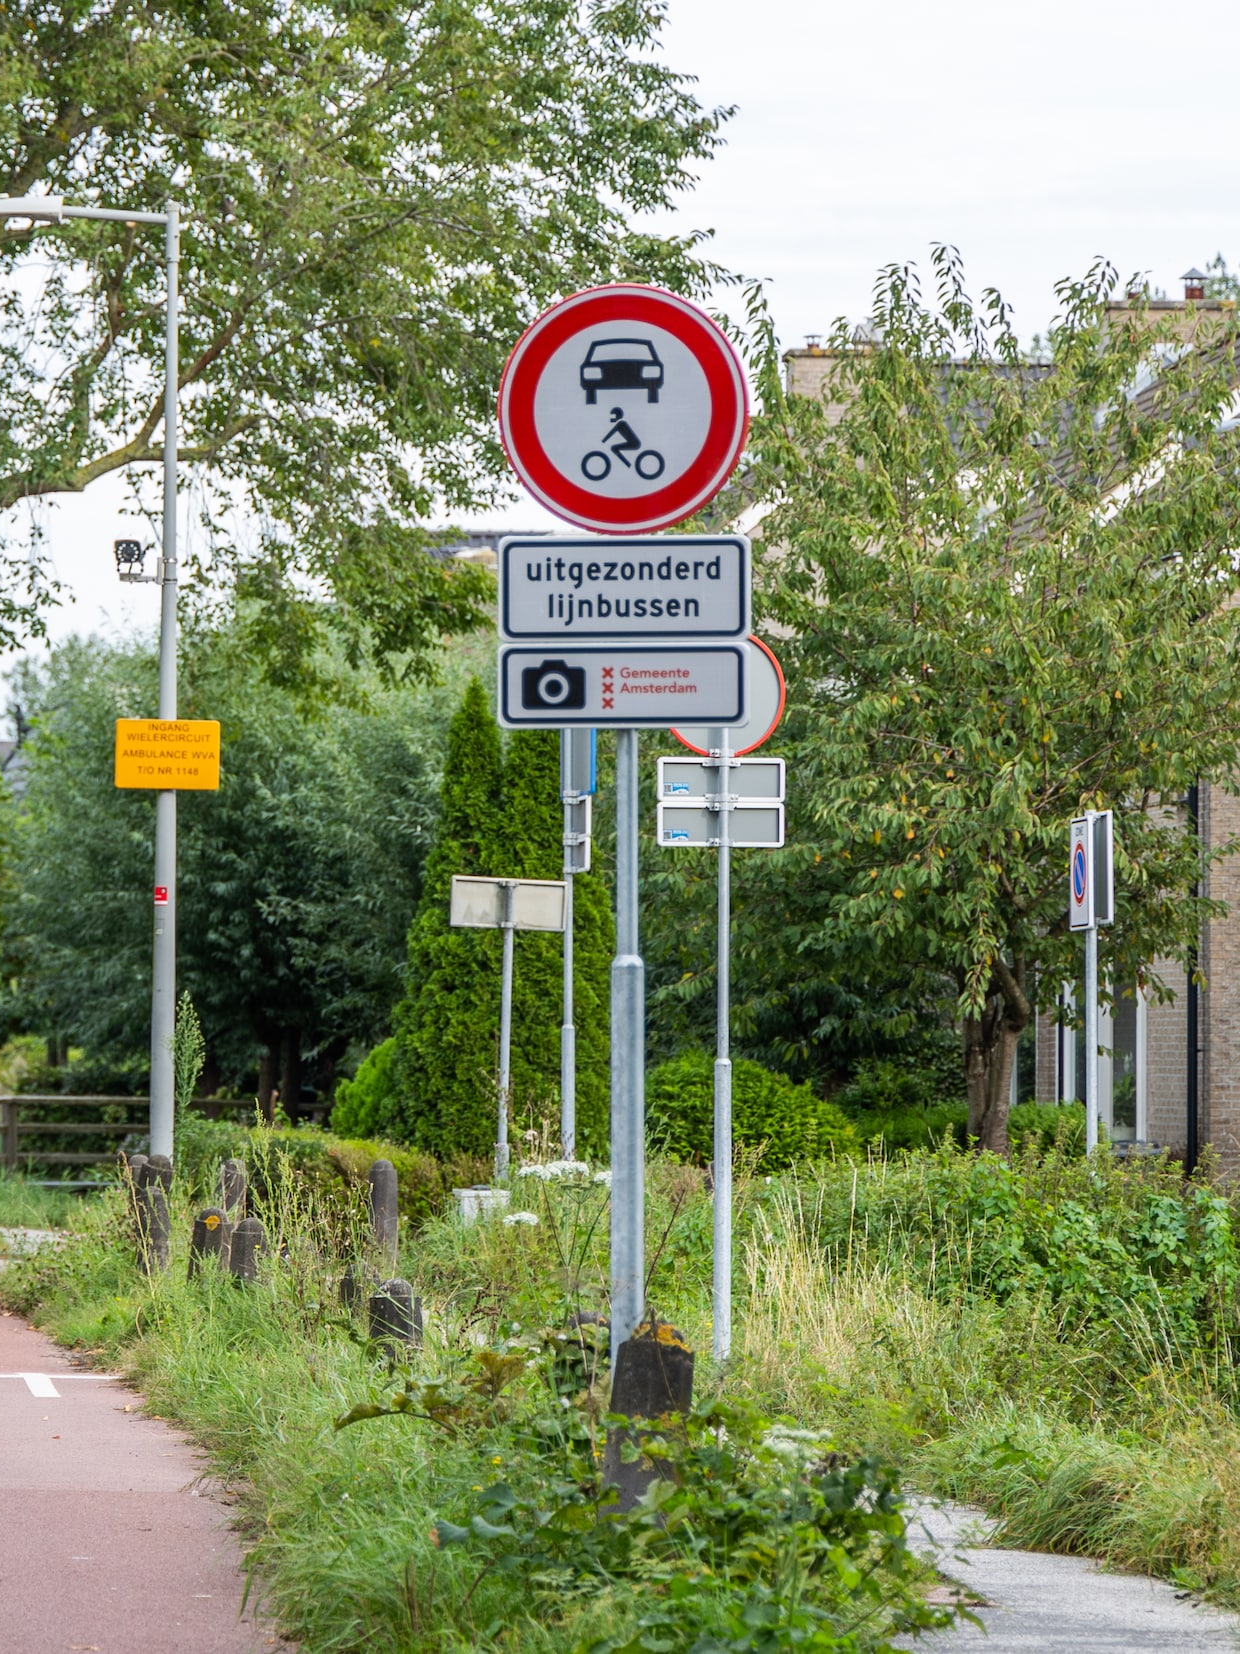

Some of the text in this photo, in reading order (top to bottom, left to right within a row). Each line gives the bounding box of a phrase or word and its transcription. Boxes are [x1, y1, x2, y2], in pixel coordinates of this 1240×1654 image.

[526, 556, 721, 589] uitgezonderd
[548, 594, 700, 626] lijnbussen
[620, 667, 690, 679] Gemeente
[620, 683, 697, 694] Amsterdam
[148, 723, 190, 732] INGANG
[127, 733, 211, 742] WIELERCIRCUIT
[122, 749, 216, 760] AMBULANCE WVA
[158, 766, 172, 775] NR
